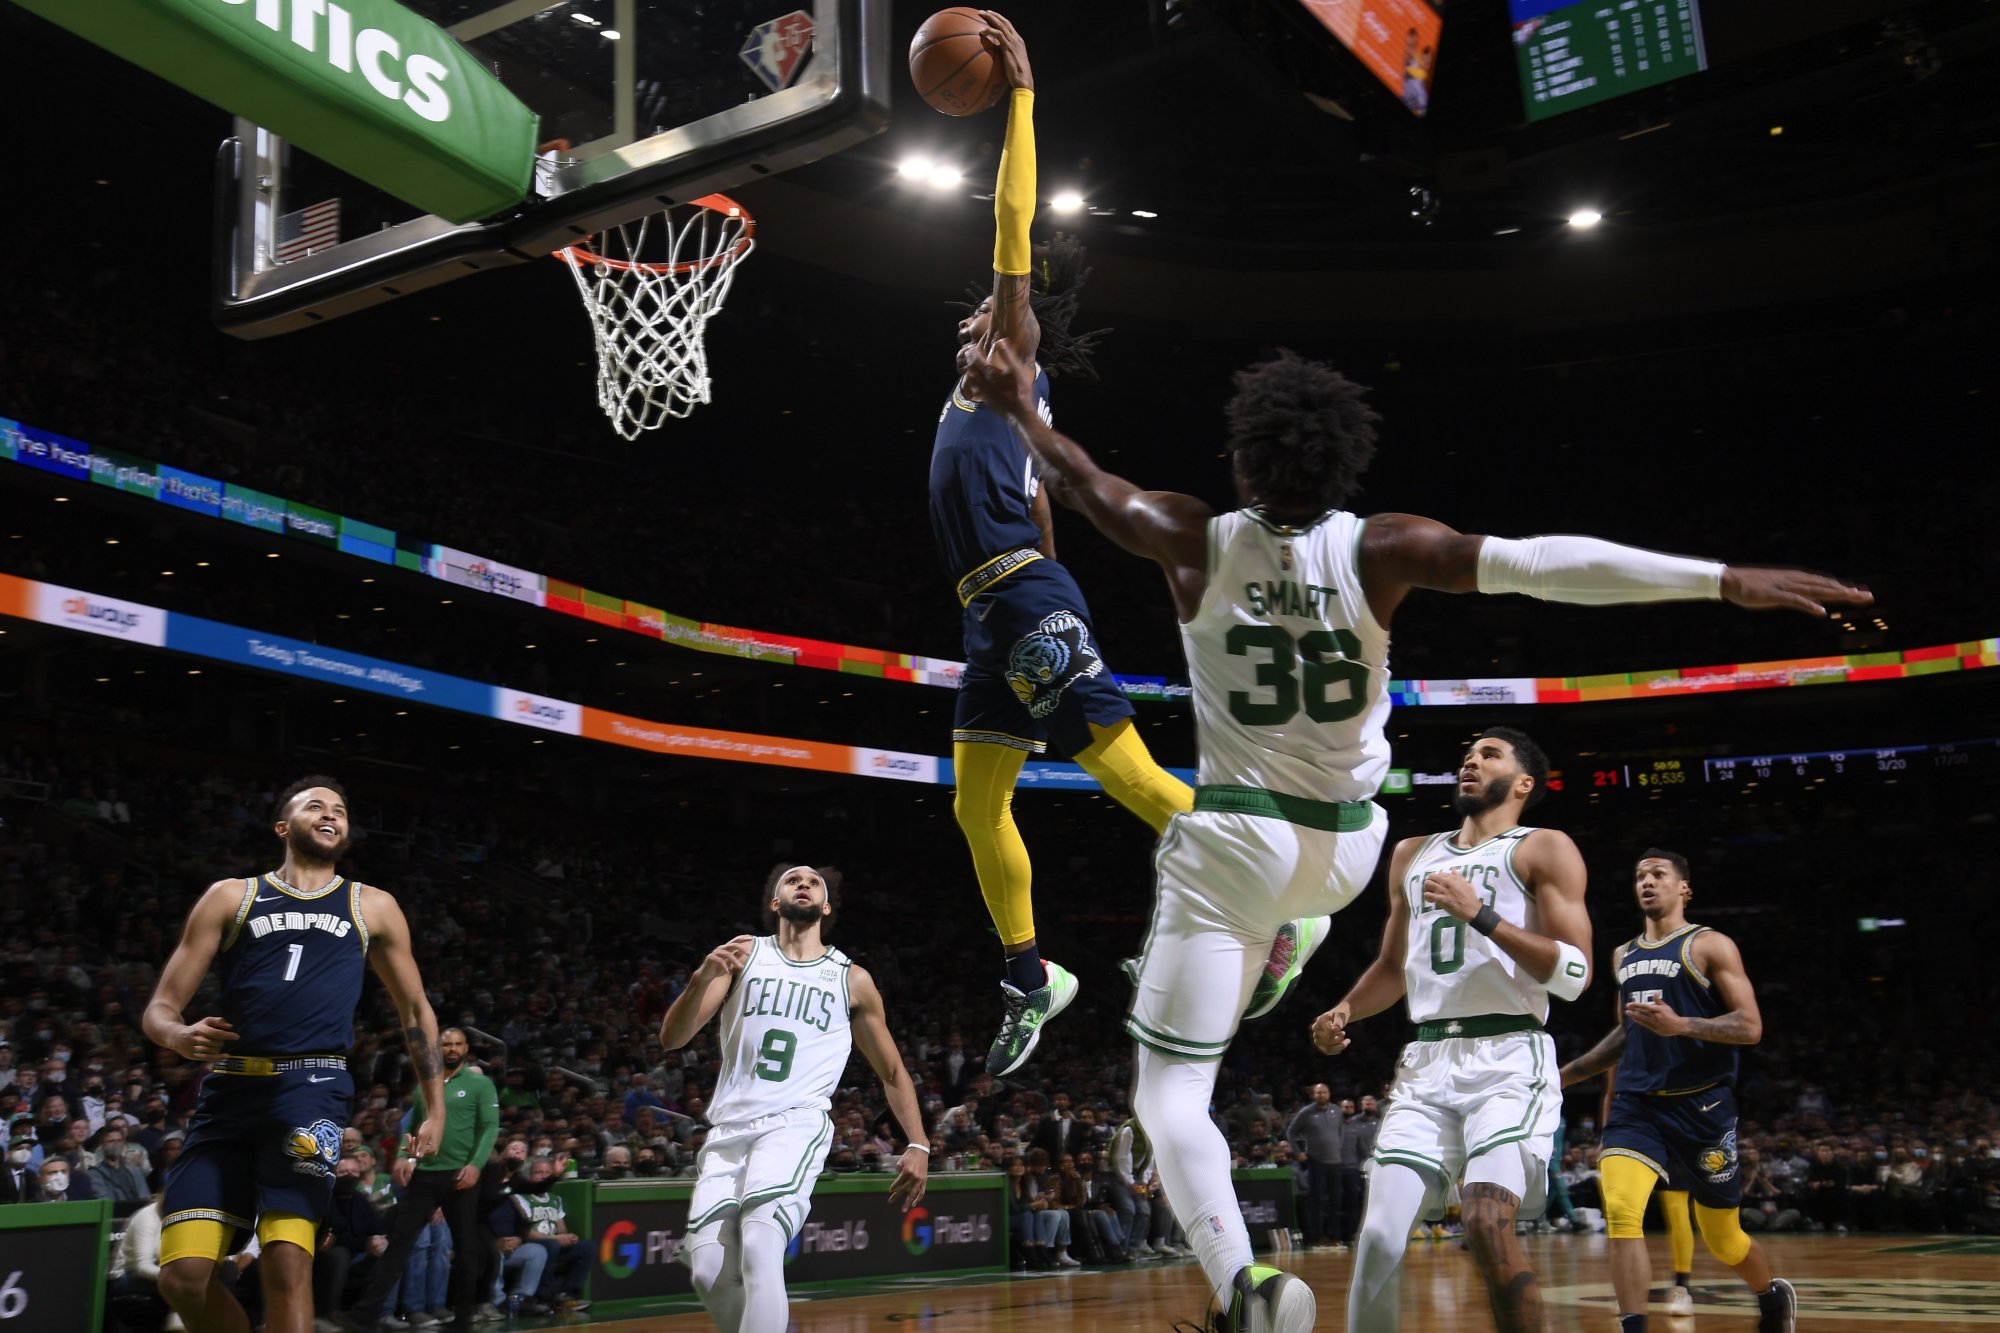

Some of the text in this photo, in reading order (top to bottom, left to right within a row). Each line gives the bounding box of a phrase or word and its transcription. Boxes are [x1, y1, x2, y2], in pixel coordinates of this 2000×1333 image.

[219, 0, 451, 122] tics
[3, 428, 48, 456] The
[116, 463, 163, 487] plan
[1245, 580, 1338, 622] SMART
[1226, 624, 1370, 726] 36
[1592, 770, 1619, 787] 21
[249, 912, 352, 938] MEMPHIS
[1431, 916, 1466, 975] 0
[284, 943, 304, 981] 1
[1618, 959, 1681, 985] MEMPHIS
[743, 977, 835, 1032] CELTICS
[755, 1028, 798, 1082] 9
[803, 1220, 870, 1254] Pixel 6
[934, 1215, 976, 1244] Pixel
[977, 1214, 992, 1242] 6
[0, 1270, 28, 1319] 6
